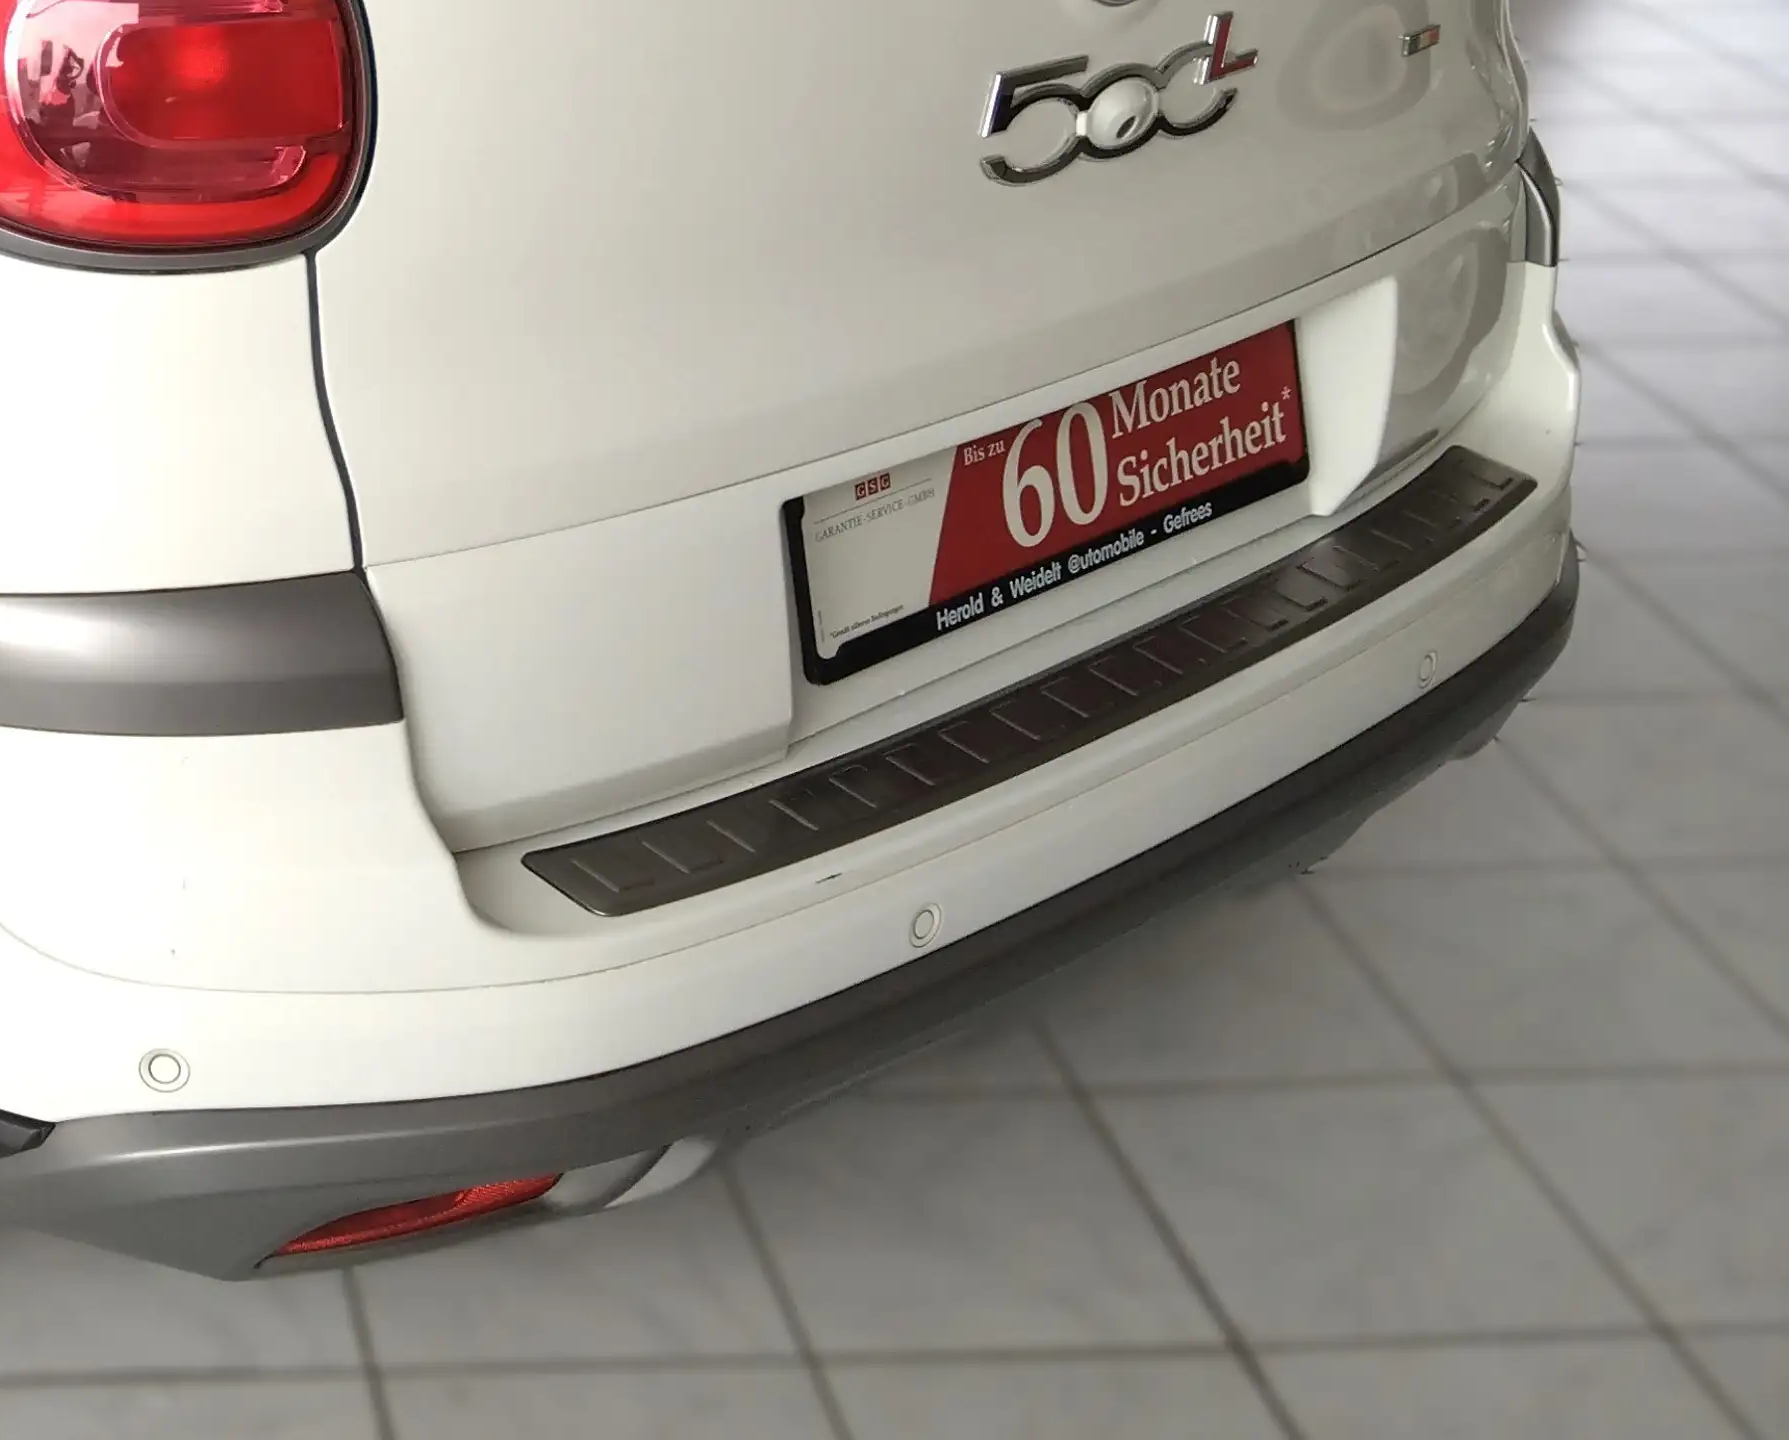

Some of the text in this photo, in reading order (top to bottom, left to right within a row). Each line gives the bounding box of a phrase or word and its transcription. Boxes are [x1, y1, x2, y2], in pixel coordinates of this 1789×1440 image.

[1110, 355, 1241, 439] Monate
[963, 439, 1006, 467] Bis zu
[1002, 401, 1109, 548] 60
[936, 592, 984, 631] Herold
[990, 586, 1004, 608] &
[1009, 561, 1062, 599] Weidelt
[1067, 528, 1145, 574] @utomobile
[1163, 501, 1213, 534] Gefrees
